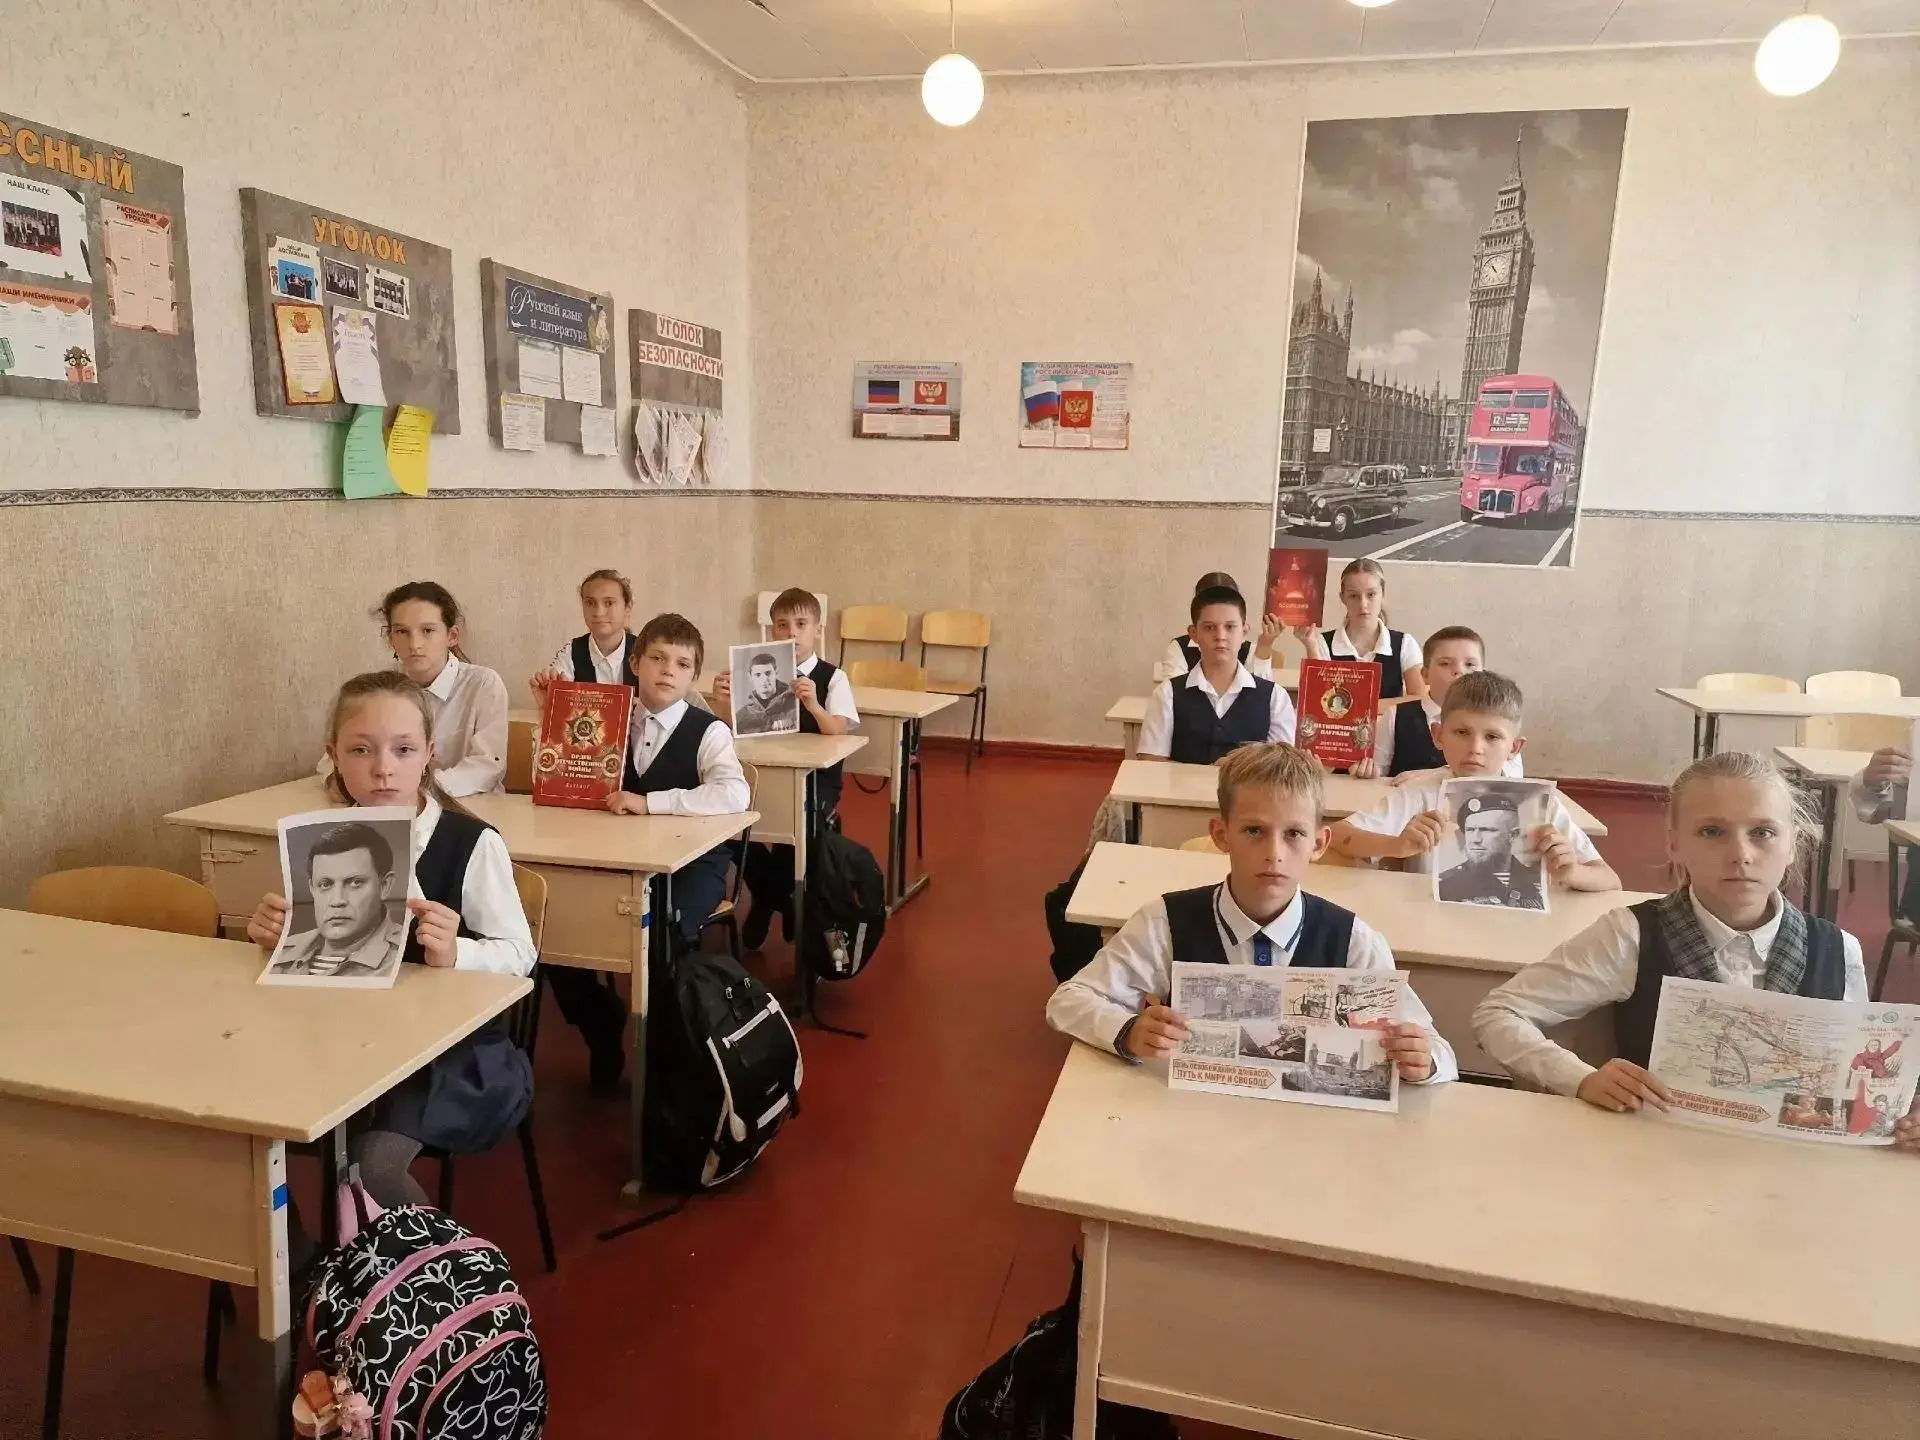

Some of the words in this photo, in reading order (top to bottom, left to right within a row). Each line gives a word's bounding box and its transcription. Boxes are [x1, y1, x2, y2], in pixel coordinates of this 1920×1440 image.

[7, 179, 25, 189] НАШ
[27, 184, 51, 196] КЛАСС
[116, 204, 158, 221] РАСПИСАНИЕ
[311, 215, 407, 265] УГОЛОК
[22, 290, 75, 304] ИМЕНИННИКИ
[510, 285, 560, 316] Русский
[562, 309, 583, 322] язык
[539, 320, 587, 343] литература
[659, 316, 702, 347] УГОЛОК
[639, 342, 723, 377] БЕЗОПАСНОСТИ
[1177, 1069, 1196, 1079] ПУТЬ
[1197, 1072, 1203, 1080] К
[1204, 1072, 1226, 1082] МИРУ
[1227, 1075, 1232, 1083] И
[1232, 1075, 1268, 1087] СВОБОДЕ
[1685, 1100, 1711, 1112] МИРУ
[1720, 1107, 1760, 1121] СВОБОДЕ
